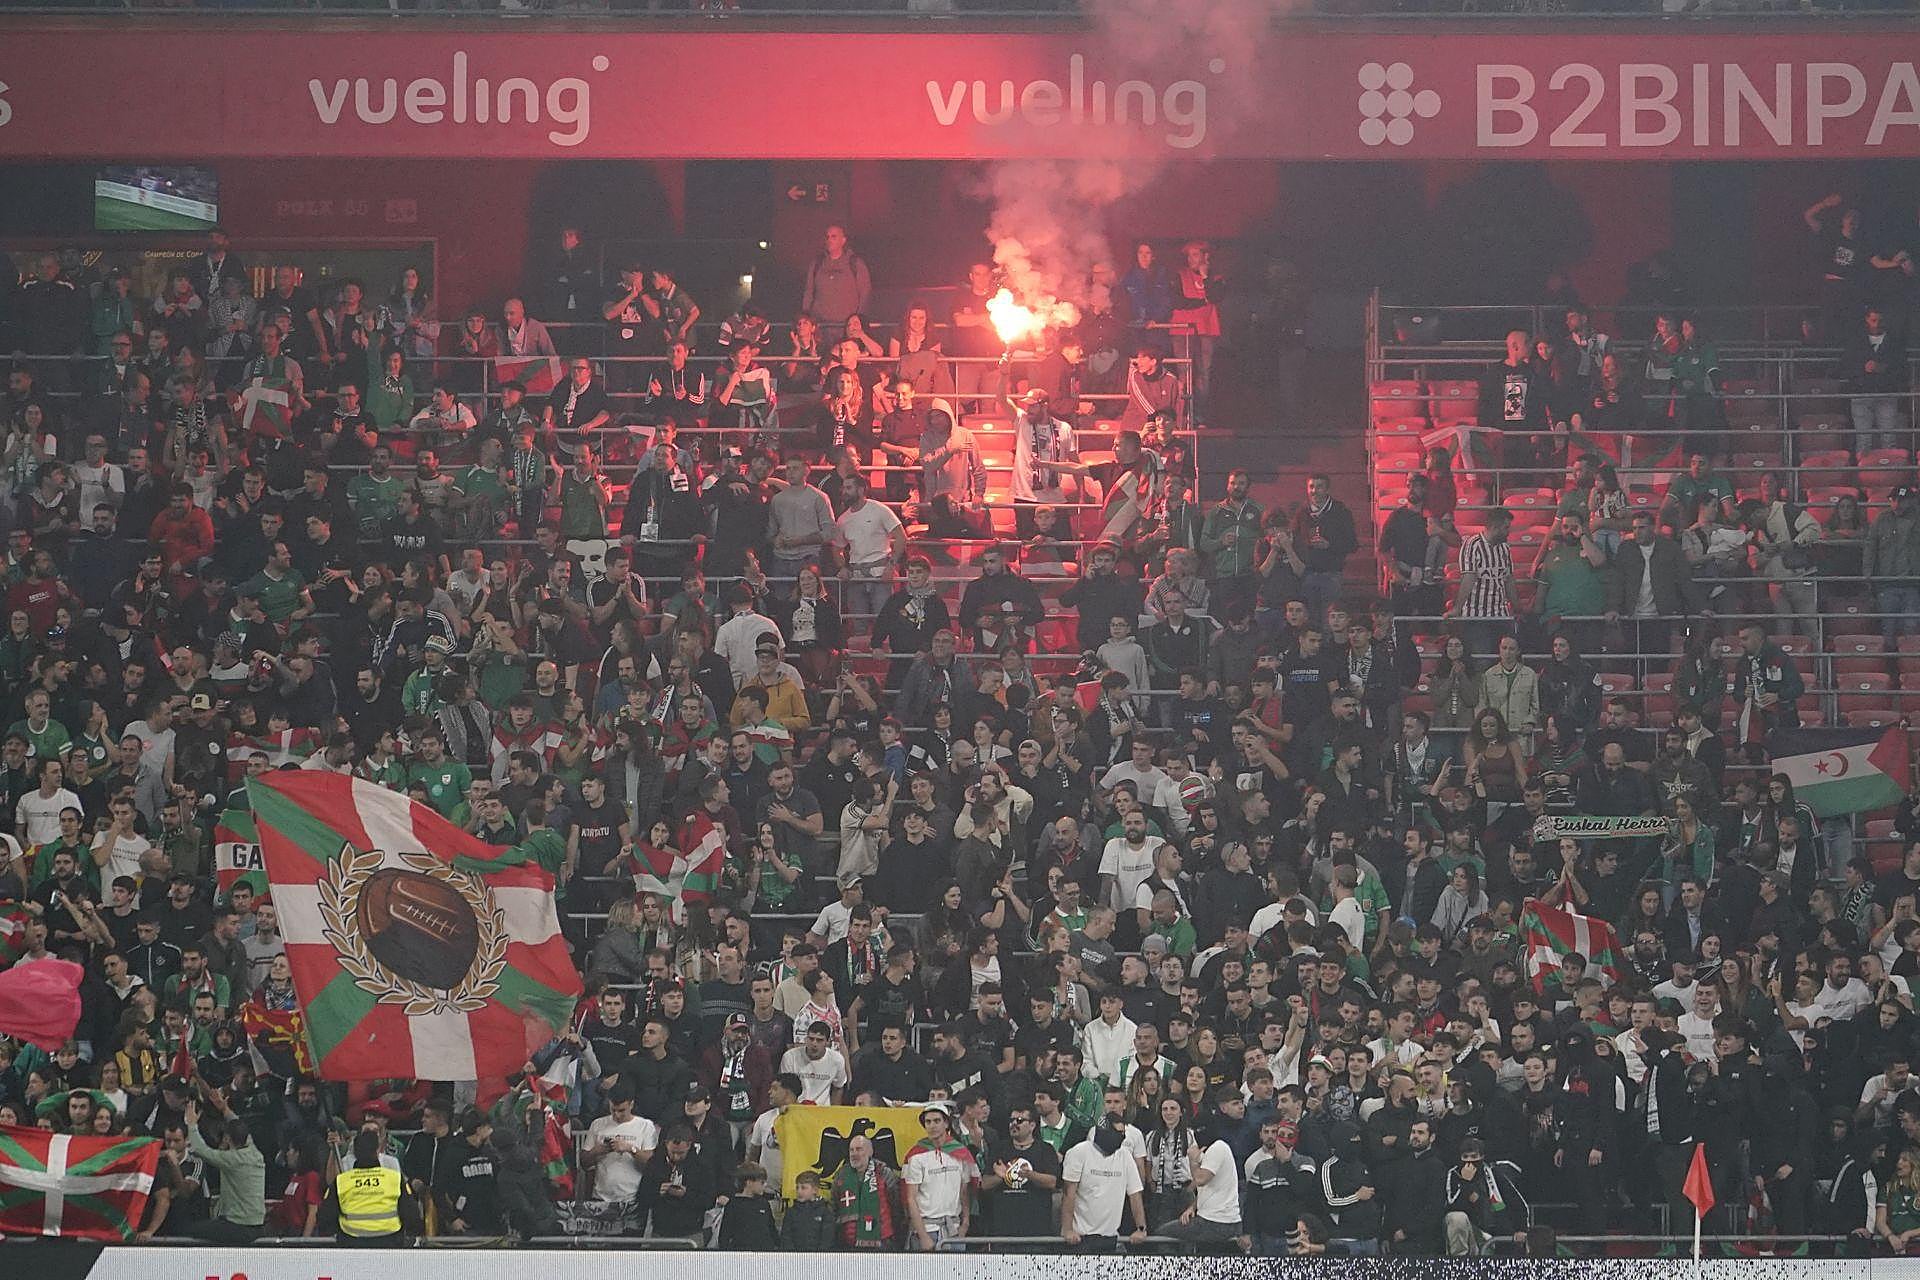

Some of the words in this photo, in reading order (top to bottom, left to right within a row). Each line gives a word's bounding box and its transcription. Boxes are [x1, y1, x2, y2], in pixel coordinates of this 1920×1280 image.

[309, 51, 609, 146] vueling
[926, 54, 1226, 148] vueling
[1476, 62, 1920, 147] B2BINPA
[1554, 817, 1611, 831] Euskal
[233, 843, 264, 869] GA
[355, 1177, 380, 1188] 543
